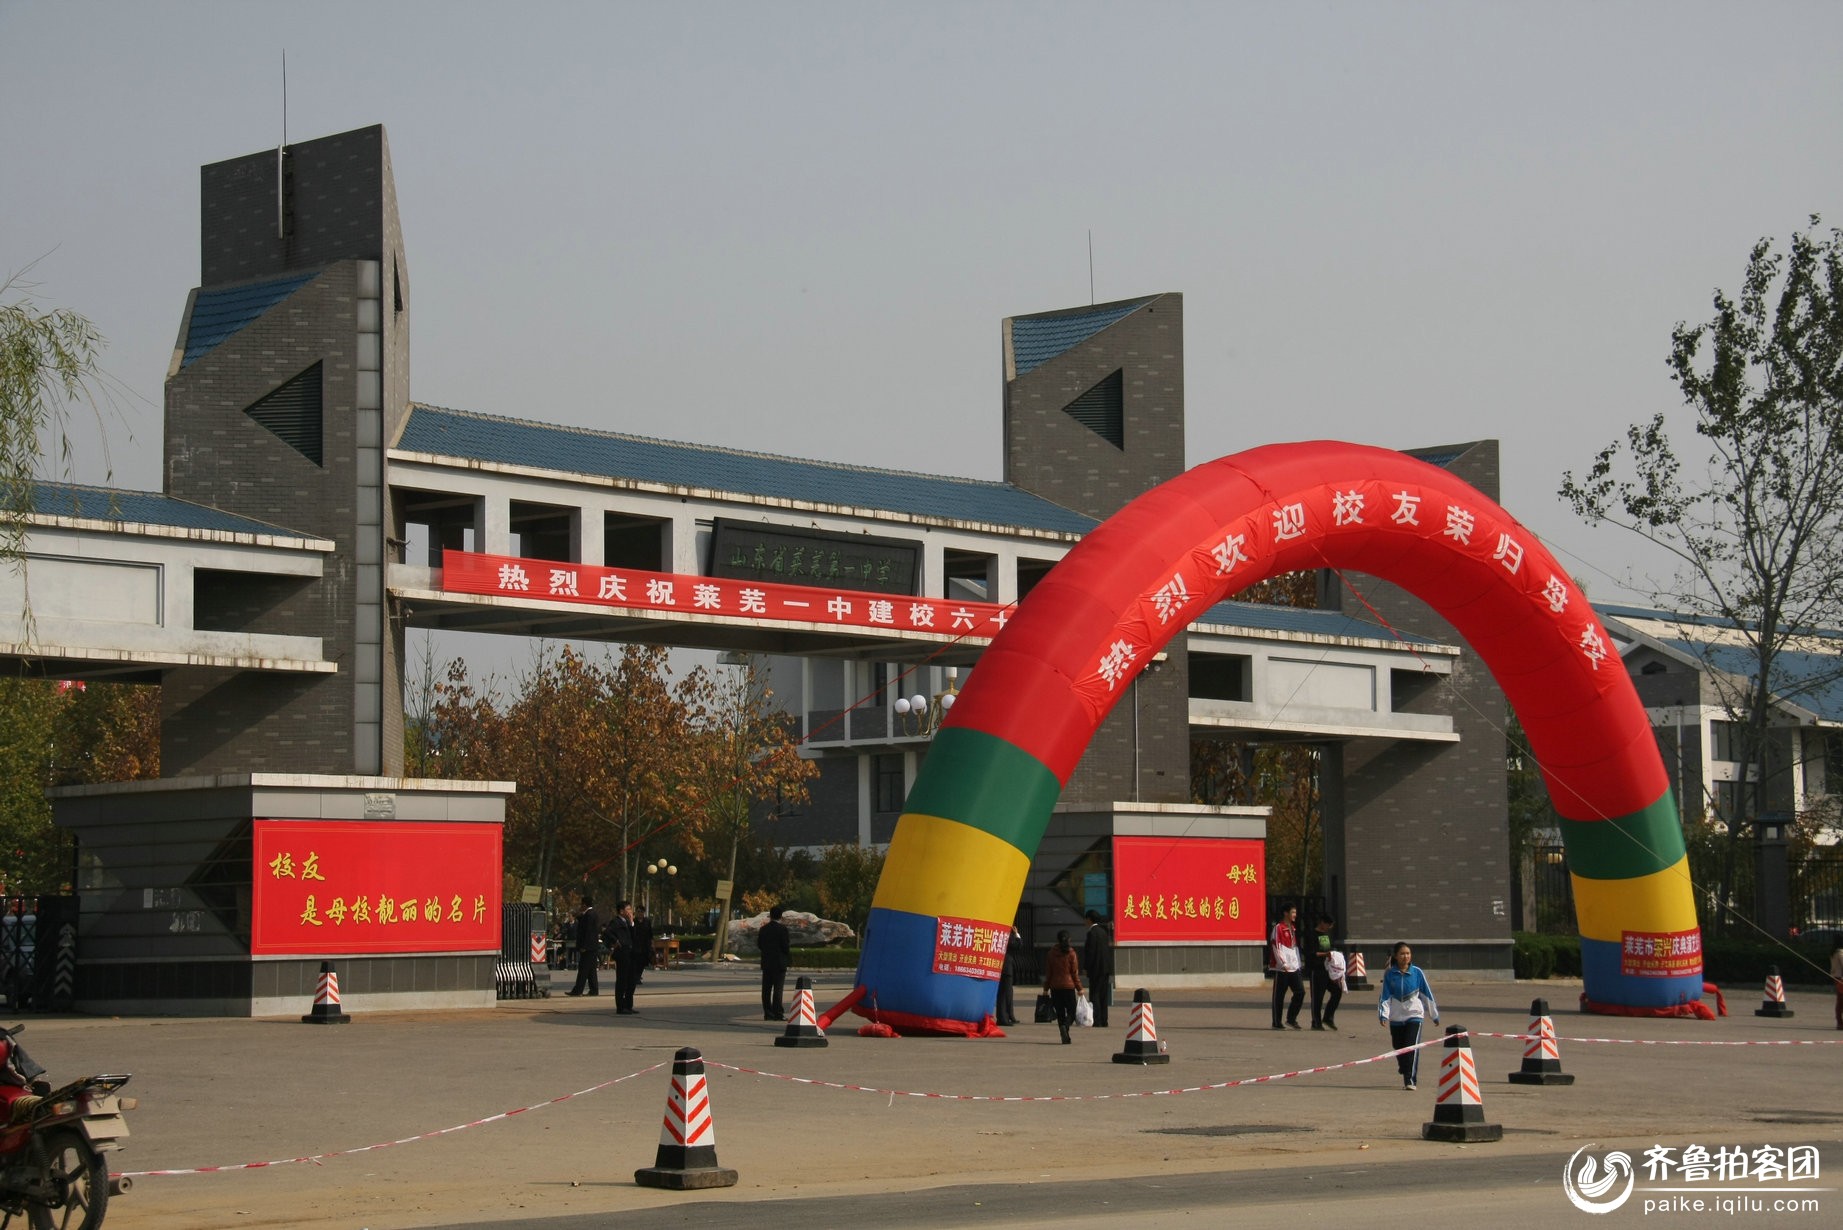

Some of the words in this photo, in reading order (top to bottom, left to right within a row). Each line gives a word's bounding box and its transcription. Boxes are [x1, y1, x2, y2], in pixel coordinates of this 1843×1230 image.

[498, 563, 1008, 631] 热烈庆祝莱芜一中建校六十
[1097, 490, 1607, 691] 热烈欢迎校友荣归母校
[268, 851, 326, 882] 校友
[1227, 863, 1257, 884] 母校
[299, 893, 487, 927] 是母校靓丽的名片
[1124, 894, 1240, 920] 是校友永远的家园
